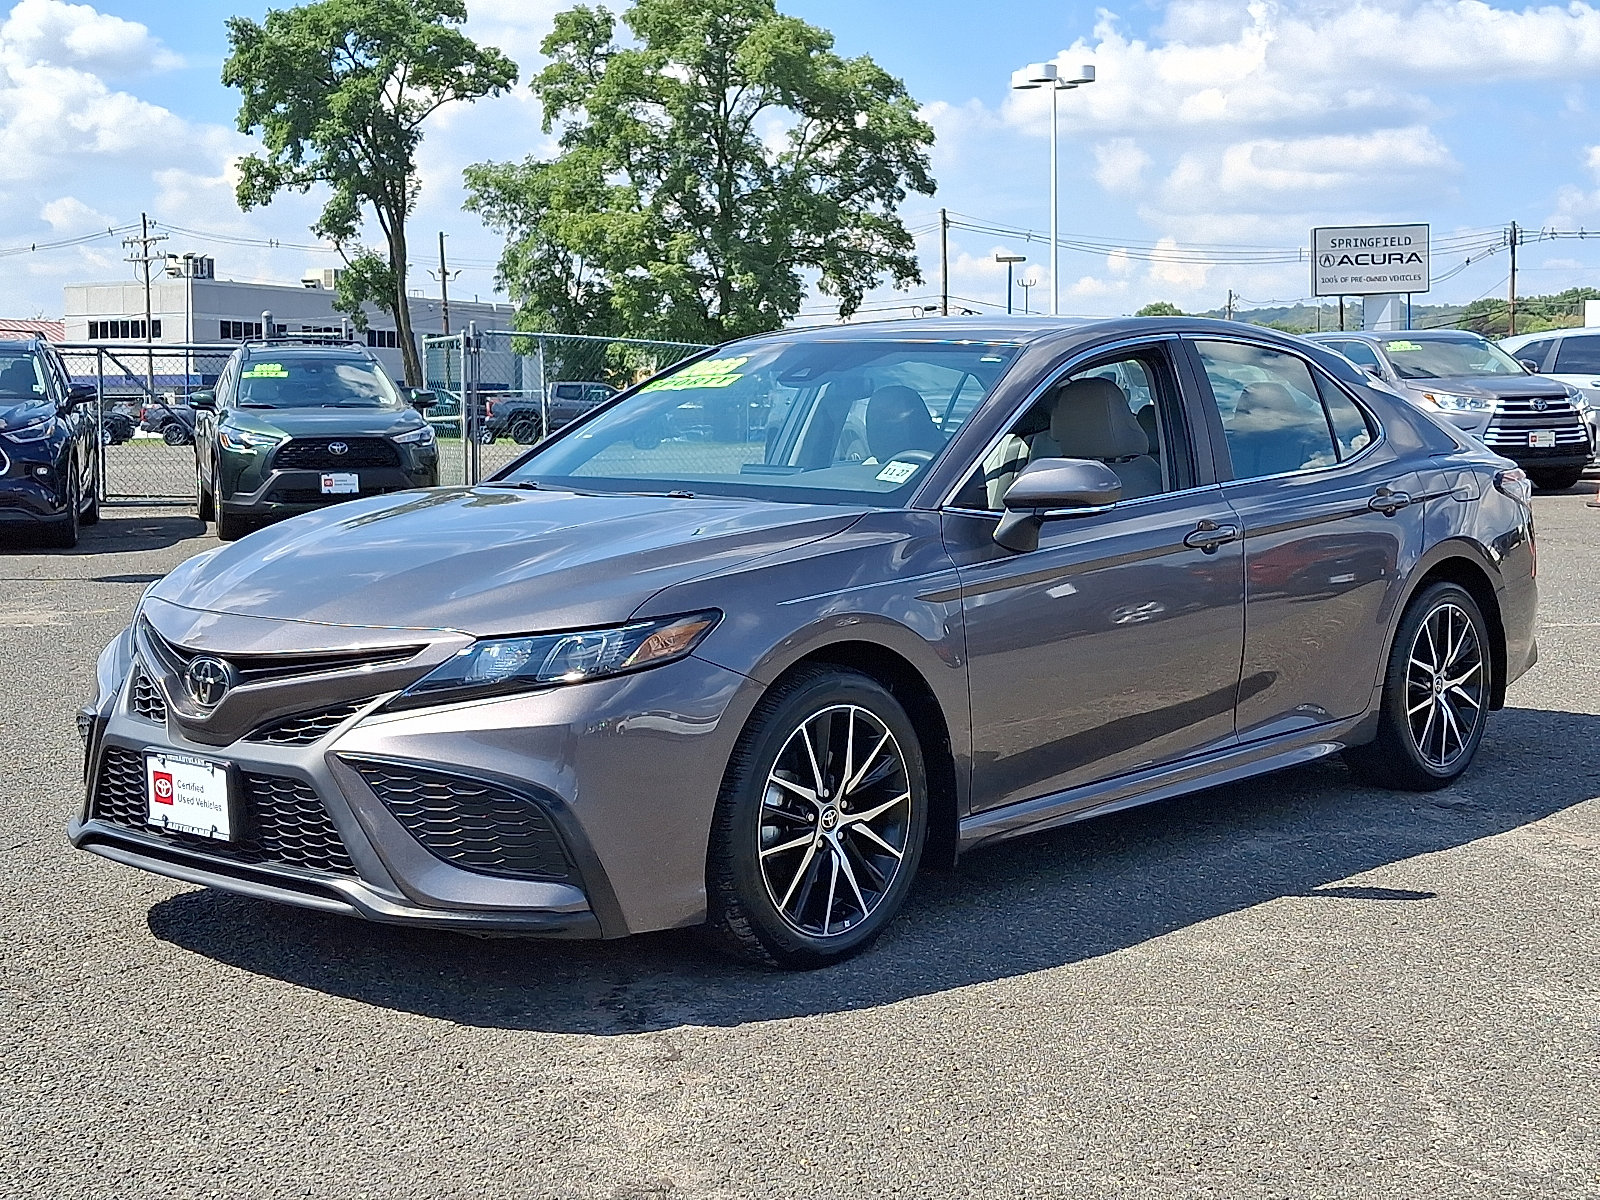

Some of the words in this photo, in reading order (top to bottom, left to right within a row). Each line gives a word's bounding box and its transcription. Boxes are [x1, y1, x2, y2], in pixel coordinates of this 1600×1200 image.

[1330, 236, 1412, 249] SPRINGFIELD
[1337, 252, 1424, 267] ACURA
[176, 779, 205, 794] Certified
[177, 793, 195, 806] Used
[195, 797, 222, 812] Vehicles
